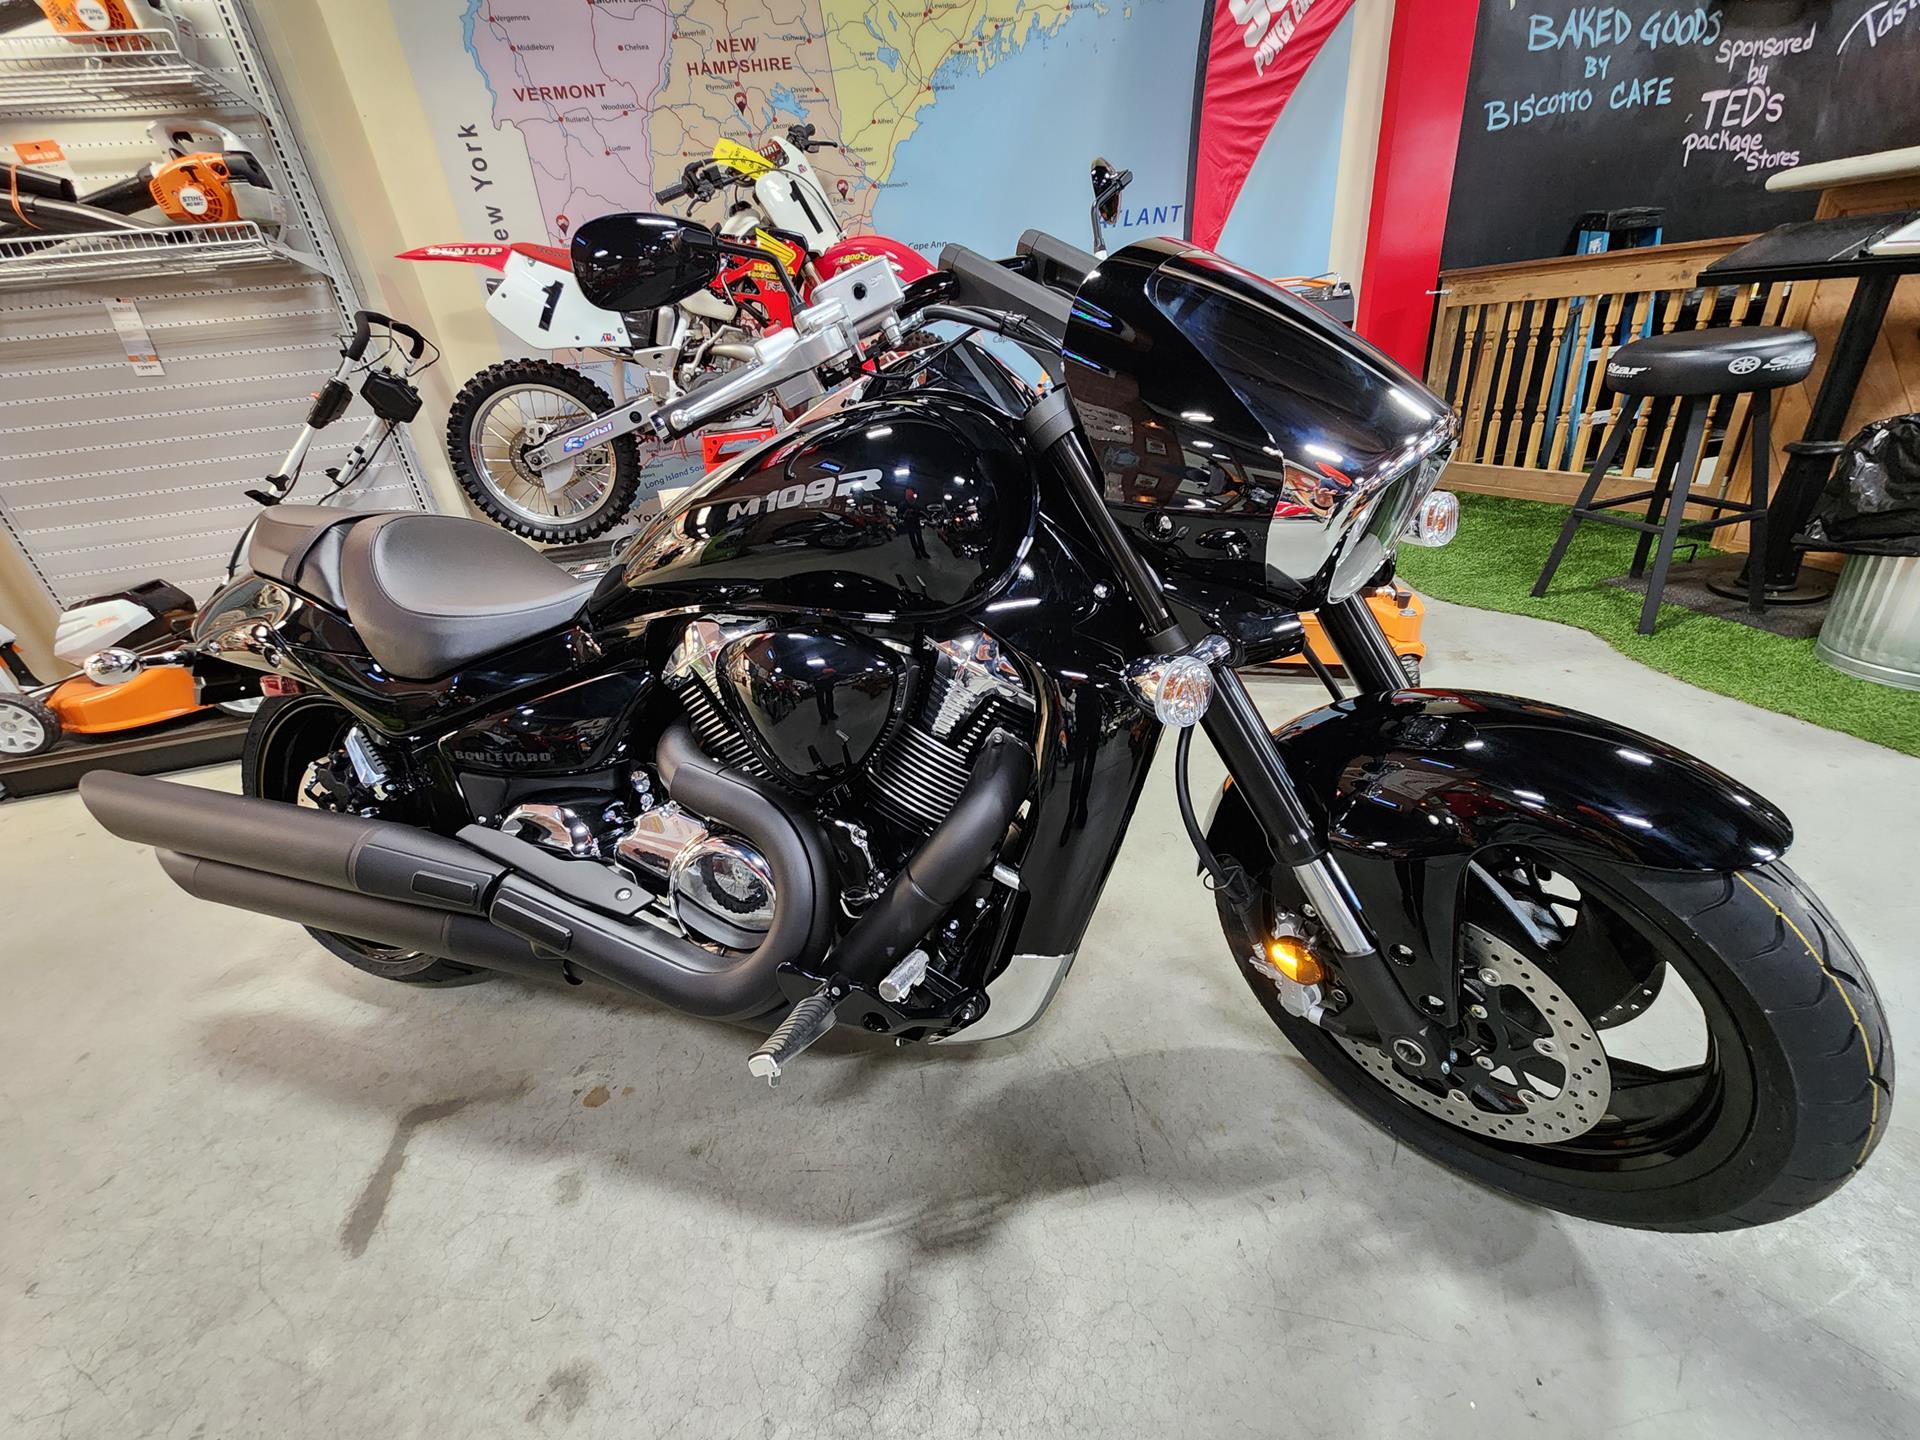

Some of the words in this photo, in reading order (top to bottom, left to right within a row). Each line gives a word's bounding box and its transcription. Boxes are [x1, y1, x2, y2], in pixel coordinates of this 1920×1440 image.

[495, 14, 530, 23] Vergennes
[678, 29, 706, 37] Haverhill
[1527, 6, 1632, 51] BAKED
[1640, 8, 1723, 51] GOODS
[516, 43, 555, 51] Middlebury
[624, 43, 650, 51] Chelsea
[715, 37, 757, 54] NEW
[1253, 9, 1296, 77] POWER
[686, 56, 793, 77] HAMPSHIRE
[1584, 55, 1612, 80] BY
[1746, 58, 1769, 86] by
[512, 83, 607, 102] VERMONT
[705, 82, 735, 93] Plymouth
[1609, 77, 1674, 111] CAFE
[600, 101, 636, 111] Woodstock
[565, 115, 590, 123] Rutland
[877, 117, 894, 125] Alfred
[457, 123, 494, 193] York
[1682, 129, 1763, 168] package
[182, 194, 204, 203] STIHL
[790, 179, 824, 235] 1
[484, 205, 509, 242] ew
[426, 246, 503, 257] DUNLOP
[908, 242, 929, 251] Cape
[930, 240, 947, 249] Ann
[538, 280, 564, 332] 1
[644, 477, 665, 490] Long
[665, 467, 689, 482] Island
[690, 463, 705, 474] Sou
[727, 468, 884, 523] M109R
[455, 751, 551, 762] BOULEVARD
